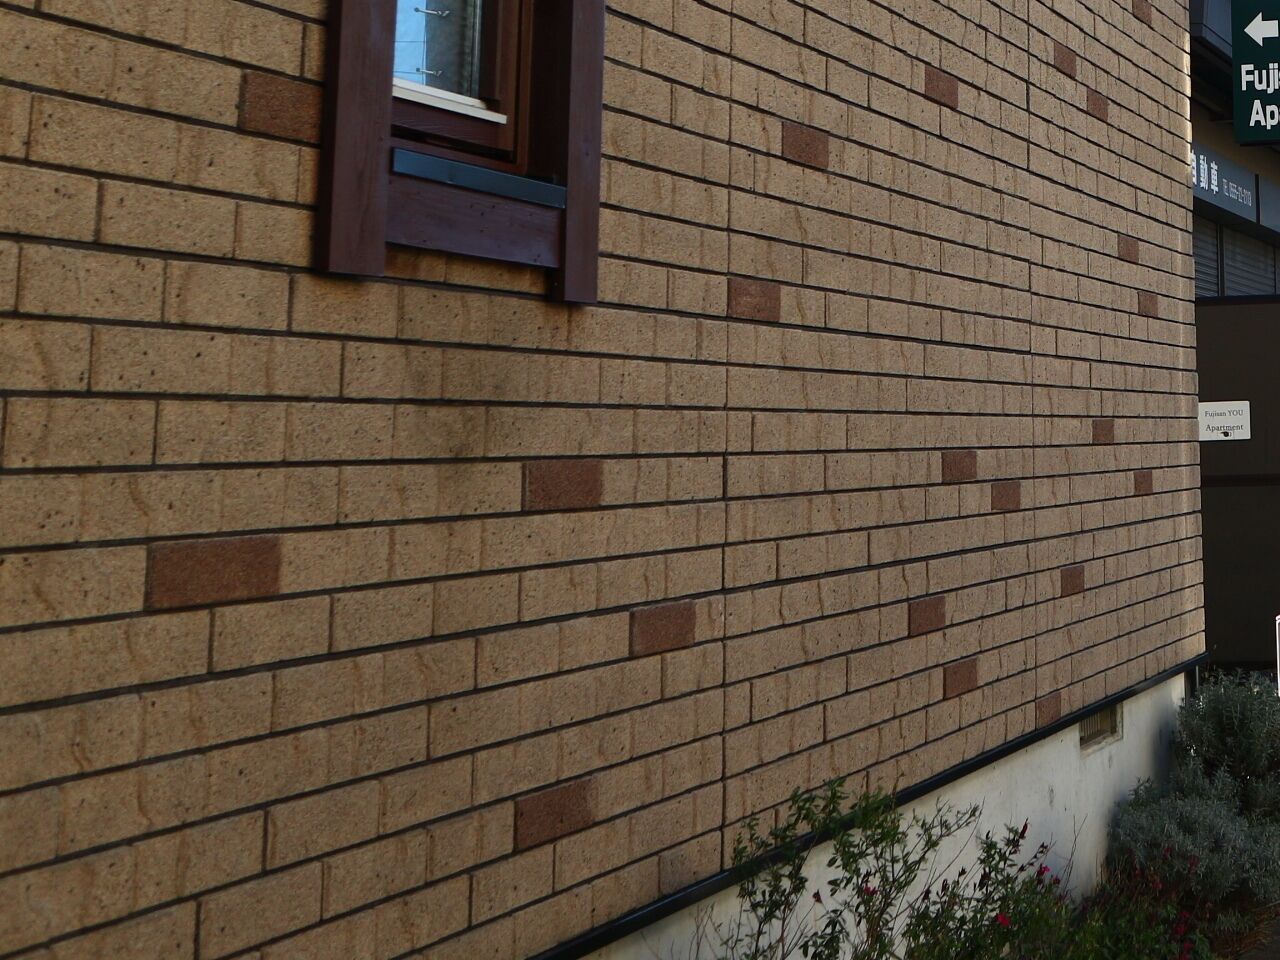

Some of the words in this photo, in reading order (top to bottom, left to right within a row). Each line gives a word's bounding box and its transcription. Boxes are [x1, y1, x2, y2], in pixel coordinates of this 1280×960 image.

[1204, 410, 1227, 418] Fujisan
[1227, 409, 1244, 417] YOU
[1205, 424, 1244, 432] Apartment
